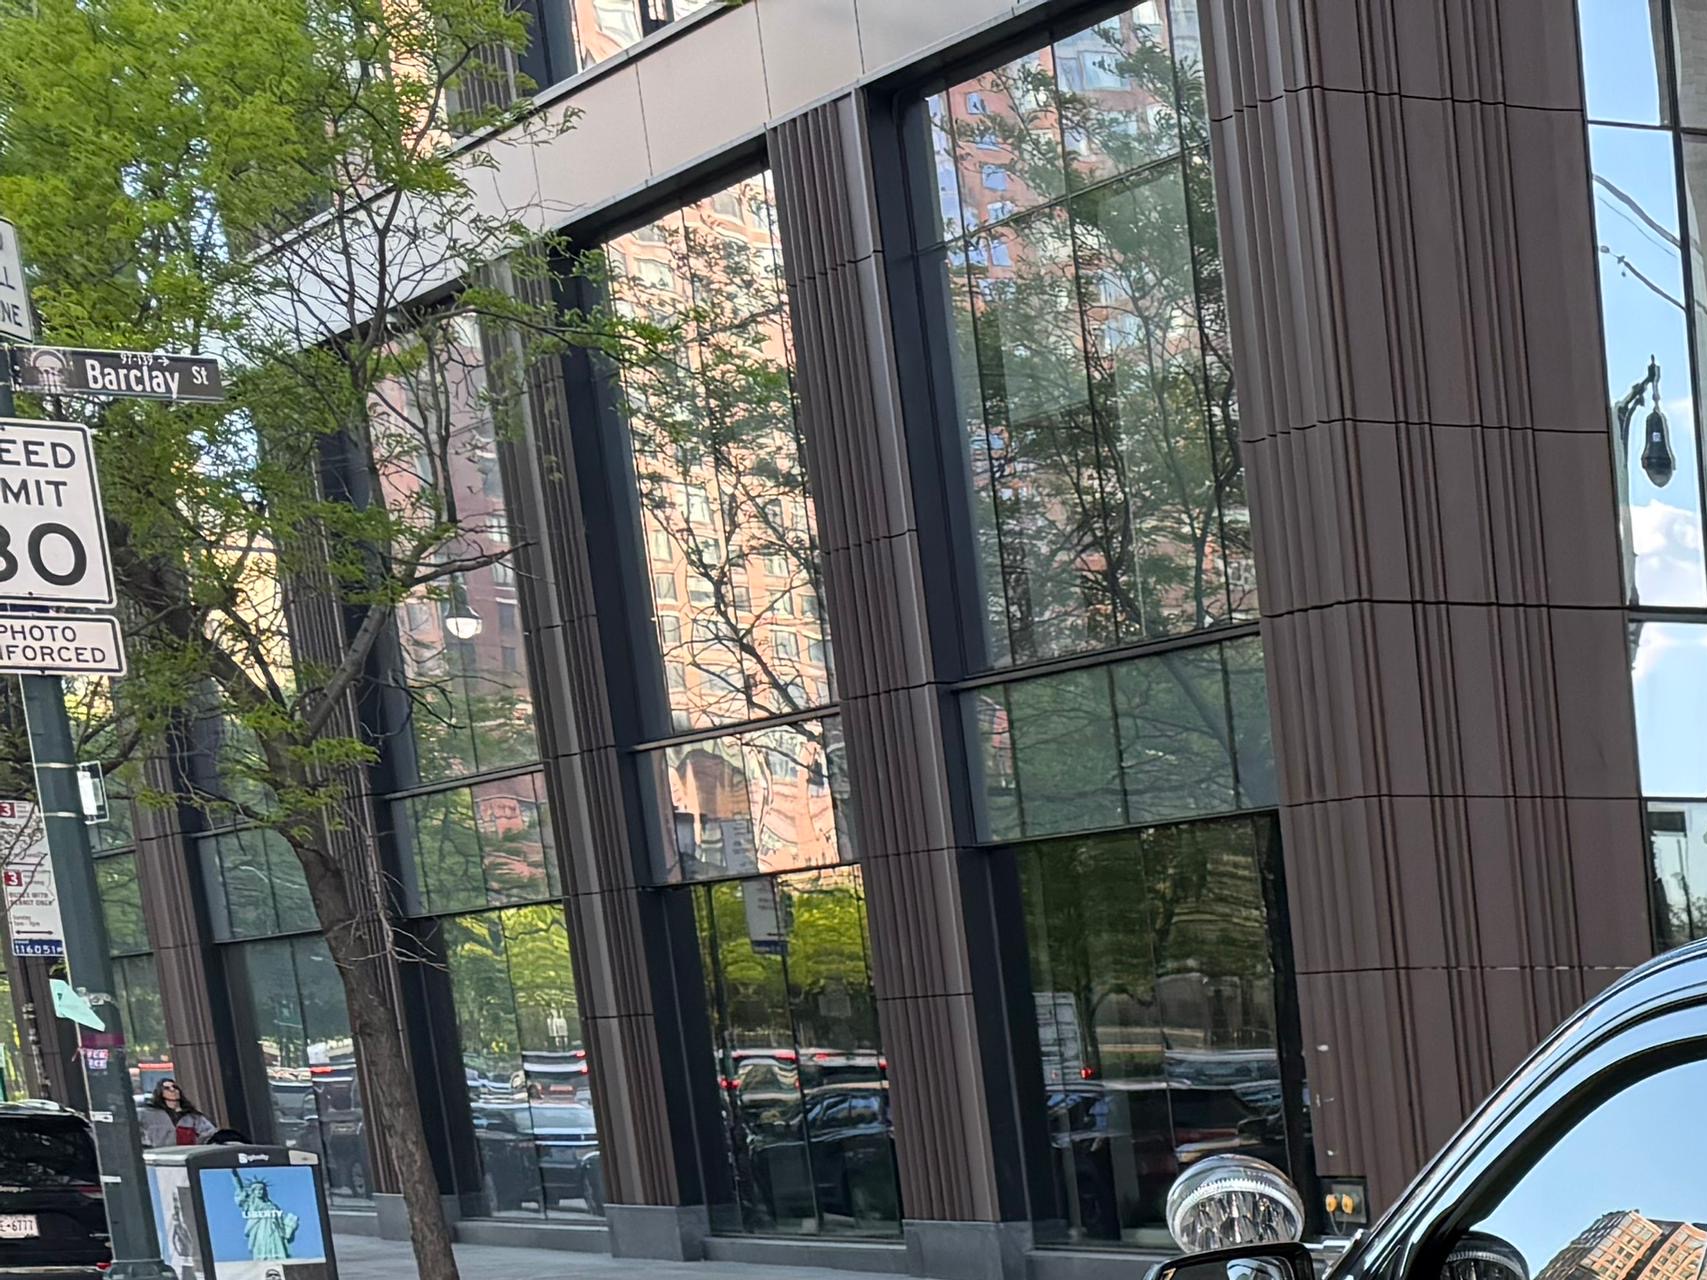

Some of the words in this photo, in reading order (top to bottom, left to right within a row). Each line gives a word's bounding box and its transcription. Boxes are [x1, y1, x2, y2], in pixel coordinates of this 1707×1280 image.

[84, 359, 180, 400] Barclay
[191, 365, 209, 386] St
[1, 803, 12, 817] 3
[8, 872, 19, 886] 3
[241, 1209, 284, 1219] LIBERTY
